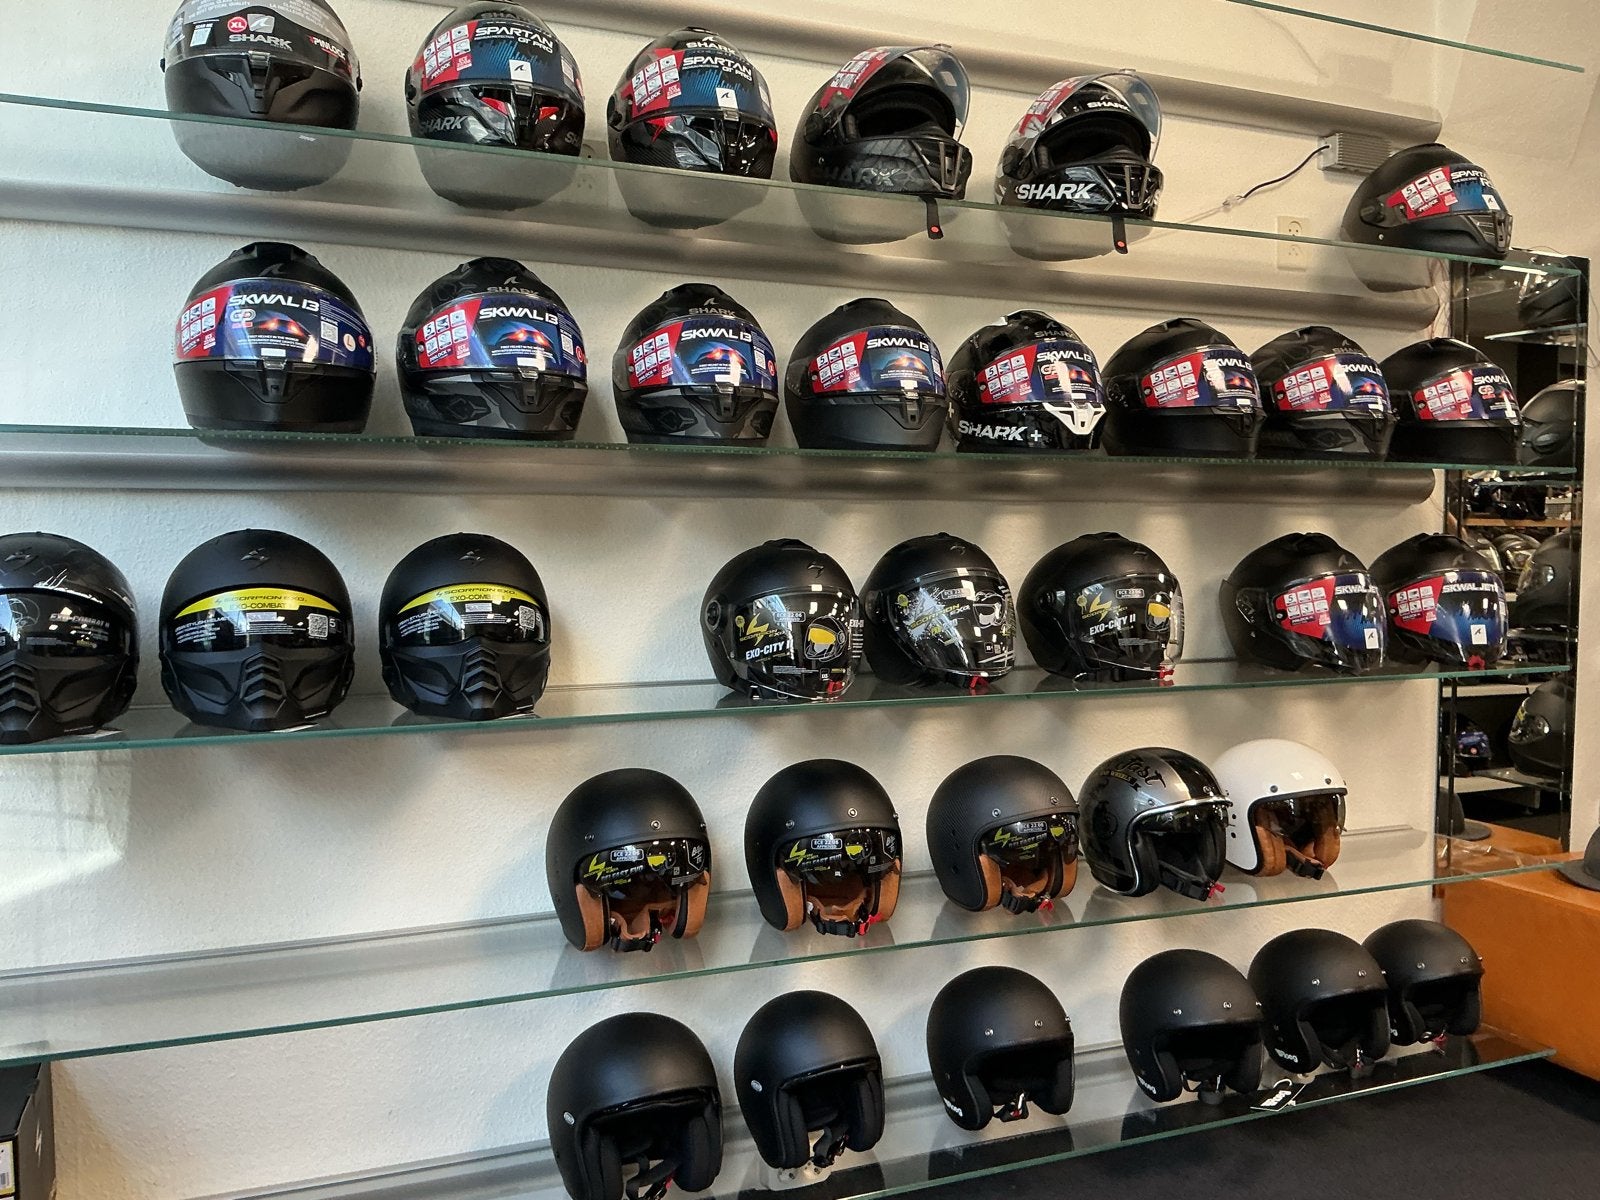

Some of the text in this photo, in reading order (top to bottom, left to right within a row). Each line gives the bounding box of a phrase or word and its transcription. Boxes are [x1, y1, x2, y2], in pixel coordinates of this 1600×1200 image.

[229, 34, 293, 47] SHARK
[475, 26, 553, 49] SPARTAN
[532, 41, 553, 54] PRO
[686, 42, 737, 55] SHARK
[683, 56, 752, 76] SPARTAN
[735, 69, 753, 81] PRO
[1086, 102, 1130, 112] SHARK
[420, 116, 468, 133] SHARK
[1017, 183, 1097, 200] SHARK
[229, 294, 299, 309] SKWAL
[479, 307, 544, 321] SKWAL
[689, 308, 736, 316] SHARK
[681, 328, 738, 341] SKWAL
[866, 337, 919, 349] SKWAL
[1036, 351, 1084, 362] SKWAL
[1203, 358, 1246, 370] KWAL
[958, 420, 1028, 441] SHARK
[1335, 585, 1366, 595] SKWAL
[1442, 583, 1480, 593] SKWAL
[329, 618, 336, 628] 5
[1089, 615, 1128, 636] EXO-CITY
[746, 640, 785, 661] EXO-CITY
[613, 850, 624, 858] ECE
